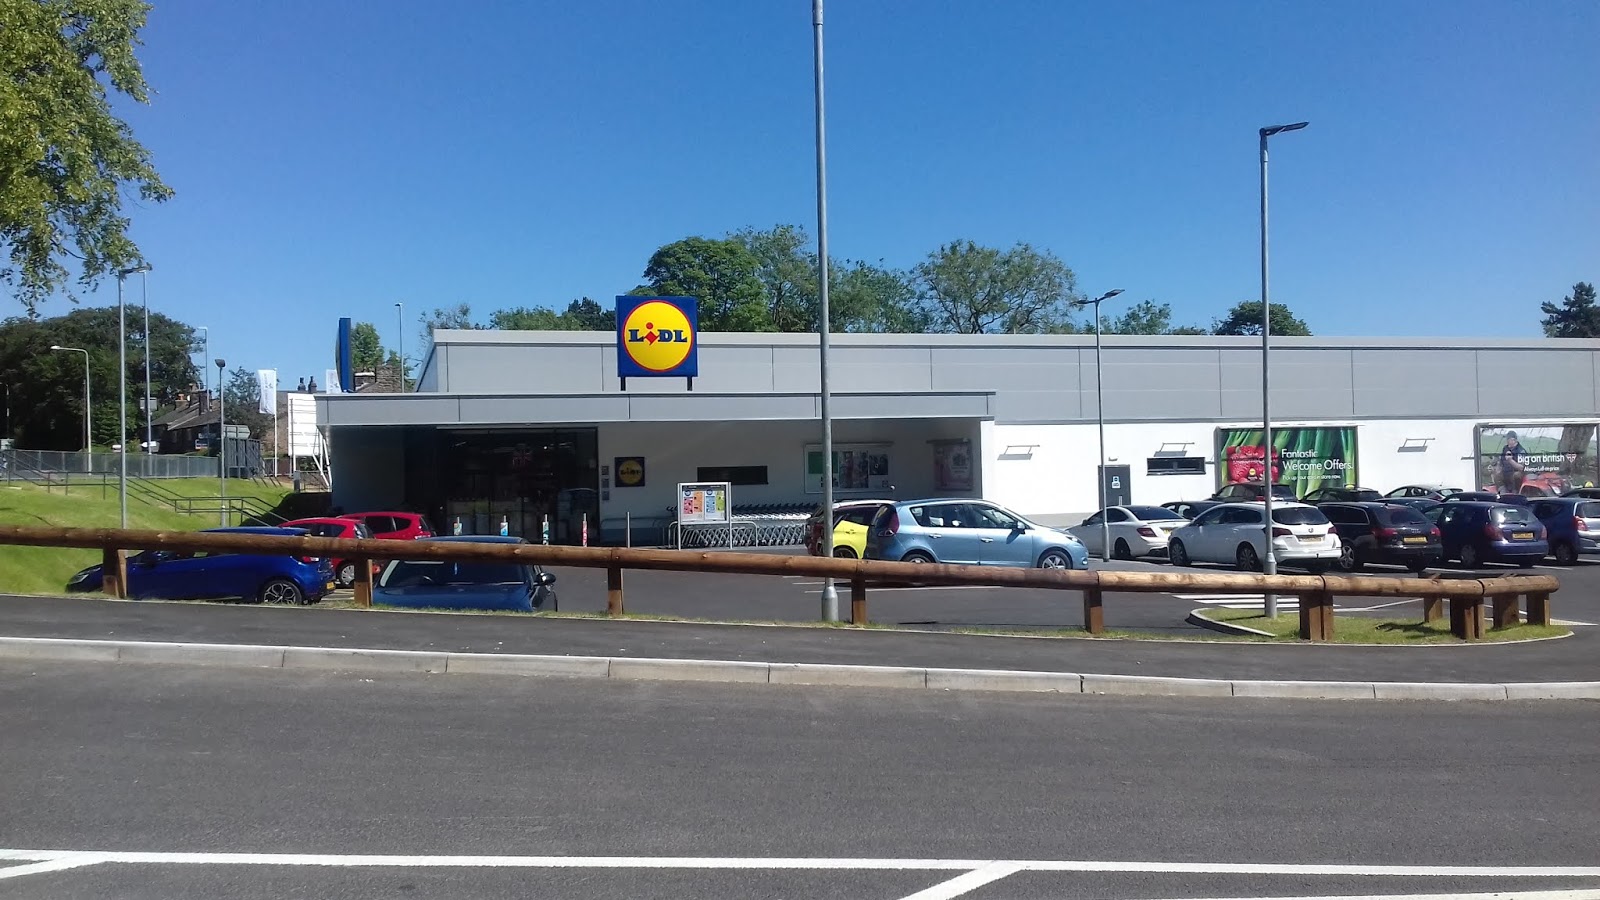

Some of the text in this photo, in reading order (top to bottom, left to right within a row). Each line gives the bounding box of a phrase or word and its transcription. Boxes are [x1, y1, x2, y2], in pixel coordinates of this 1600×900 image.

[1282, 449, 1318, 458] Fantastic
[1517, 454, 1565, 465] Big on British
[1283, 460, 1321, 470] Welcome
